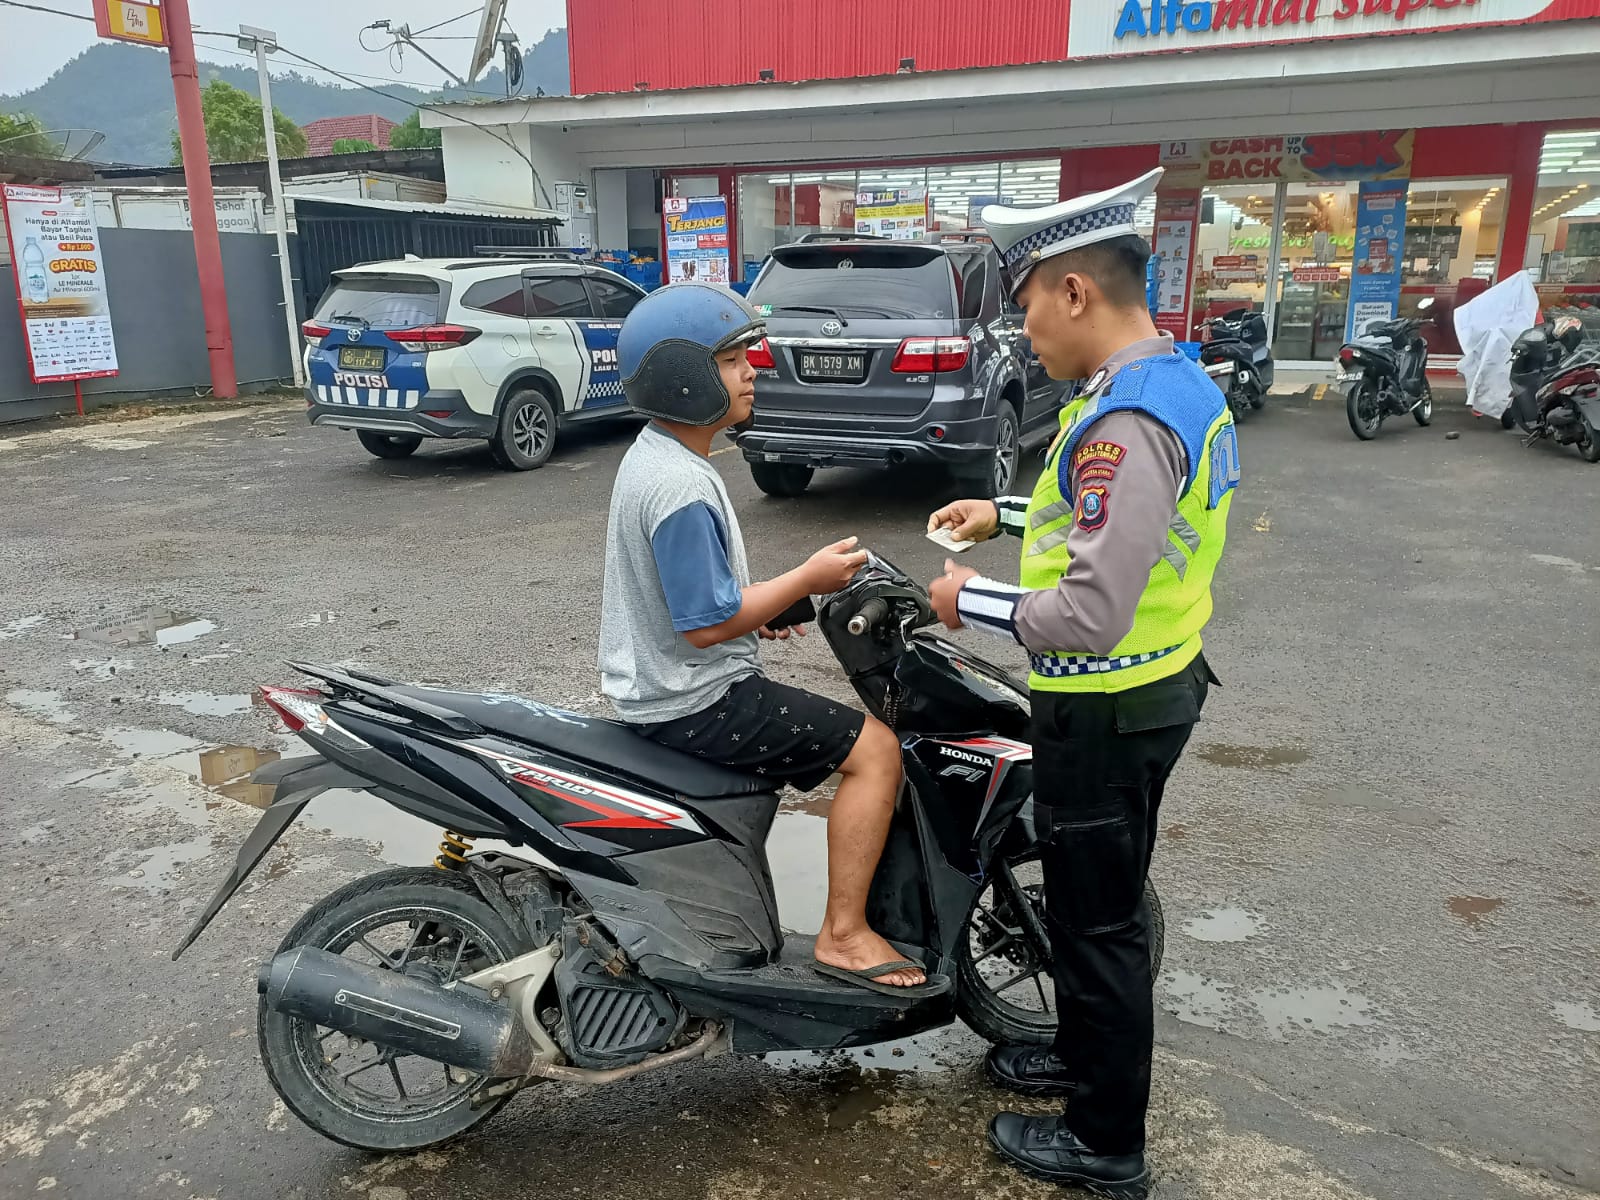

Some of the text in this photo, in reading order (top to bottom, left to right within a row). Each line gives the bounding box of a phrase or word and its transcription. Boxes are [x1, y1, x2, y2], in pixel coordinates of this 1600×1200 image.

[1287, 146, 1300, 154] TO
[1207, 157, 1283, 180] BACK
[215, 201, 245, 211] Sehat
[25, 217, 49, 226] Hanya
[50, 258, 97, 273] GRATIS
[803, 355, 861, 370] BK 1579 XM
[334, 372, 389, 388] POLISI
[1077, 442, 1121, 459] POLRES
[940, 746, 994, 767] HONDA
[940, 764, 987, 782] FI
